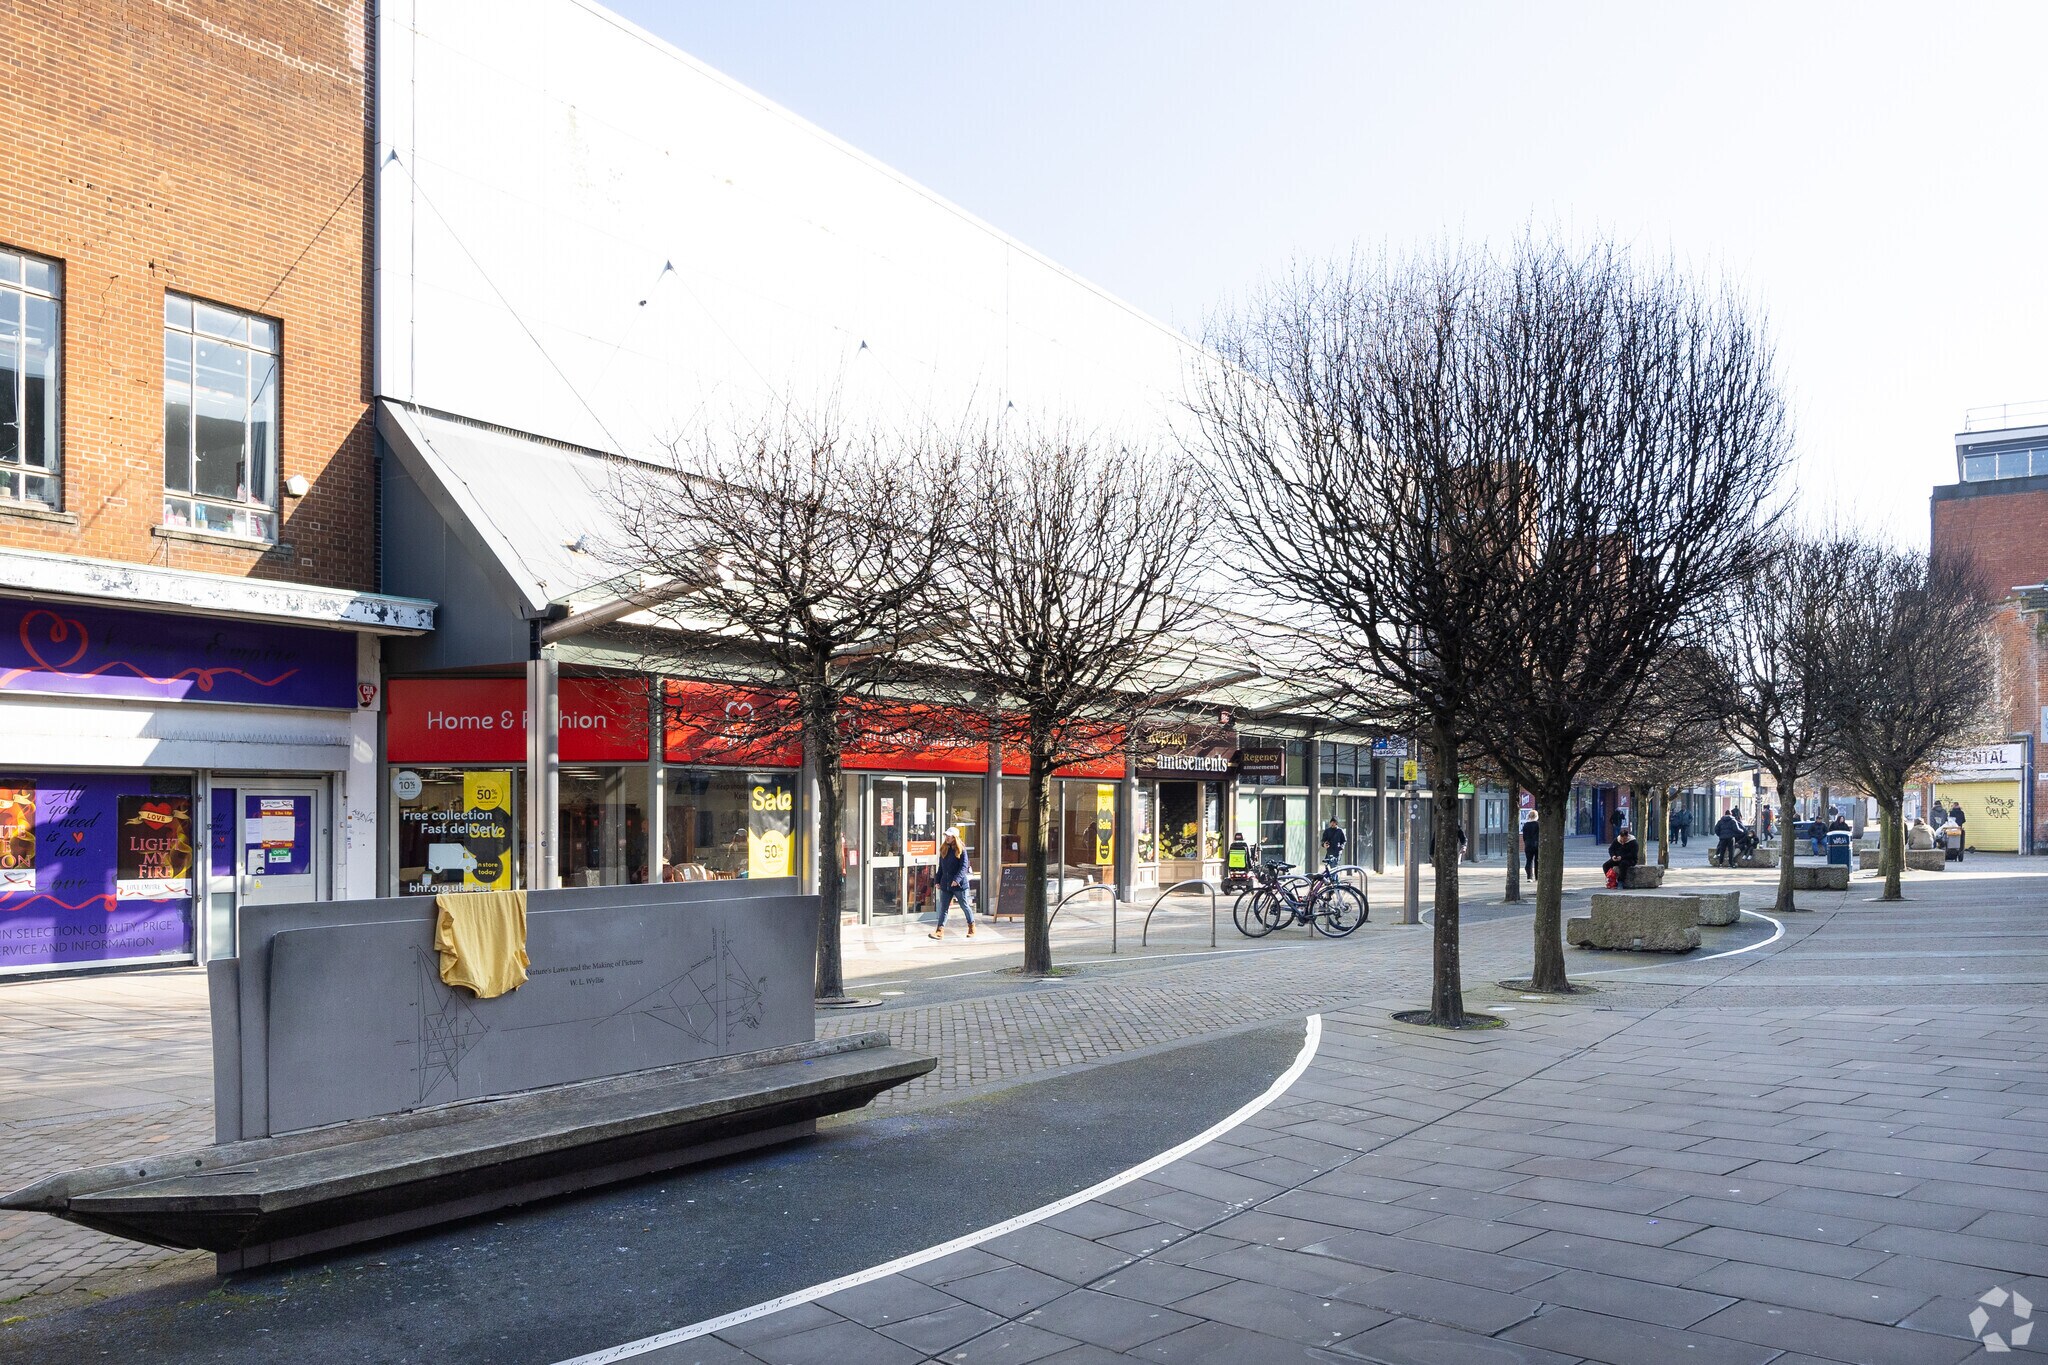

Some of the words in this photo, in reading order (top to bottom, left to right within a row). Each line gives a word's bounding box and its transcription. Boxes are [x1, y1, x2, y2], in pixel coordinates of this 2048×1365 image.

[427, 711, 493, 729] Home
[501, 710, 515, 729] &
[522, 711, 607, 729] Fhion
[1157, 755, 1228, 772] amusements
[1243, 753, 1279, 763] Regency
[399, 781, 416, 790] 10%
[45, 783, 87, 805] All
[477, 789, 497, 800] 50%
[752, 786, 793, 811] Sale
[49, 804, 79, 824] you
[58, 811, 101, 828] need
[147, 813, 165, 822] LOVE
[403, 811, 428, 820] Free
[431, 810, 493, 820] collection
[421, 823, 447, 834] Fast
[450, 822, 499, 835] delivery
[1098, 819, 1112, 830] Sale
[45, 830, 60, 843] is
[54, 840, 86, 857] love
[130, 837, 181, 851] LIGHT
[143, 853, 169, 865] MY
[138, 865, 173, 878] FIRE
[16, 925, 85, 939] SELECTION,
[88, 922, 140, 935] QUALITY,
[143, 920, 175, 931] PRICE,
[40, 942, 68, 953] AND
[71, 937, 155, 951] INFORMATION
[525, 967, 552, 976] Nature's
[552, 966, 569, 974] Laws
[569, 964, 581, 972] and
[582, 963, 592, 971] the
[592, 962, 614, 970] Making
[621, 959, 644, 967] Pictures
